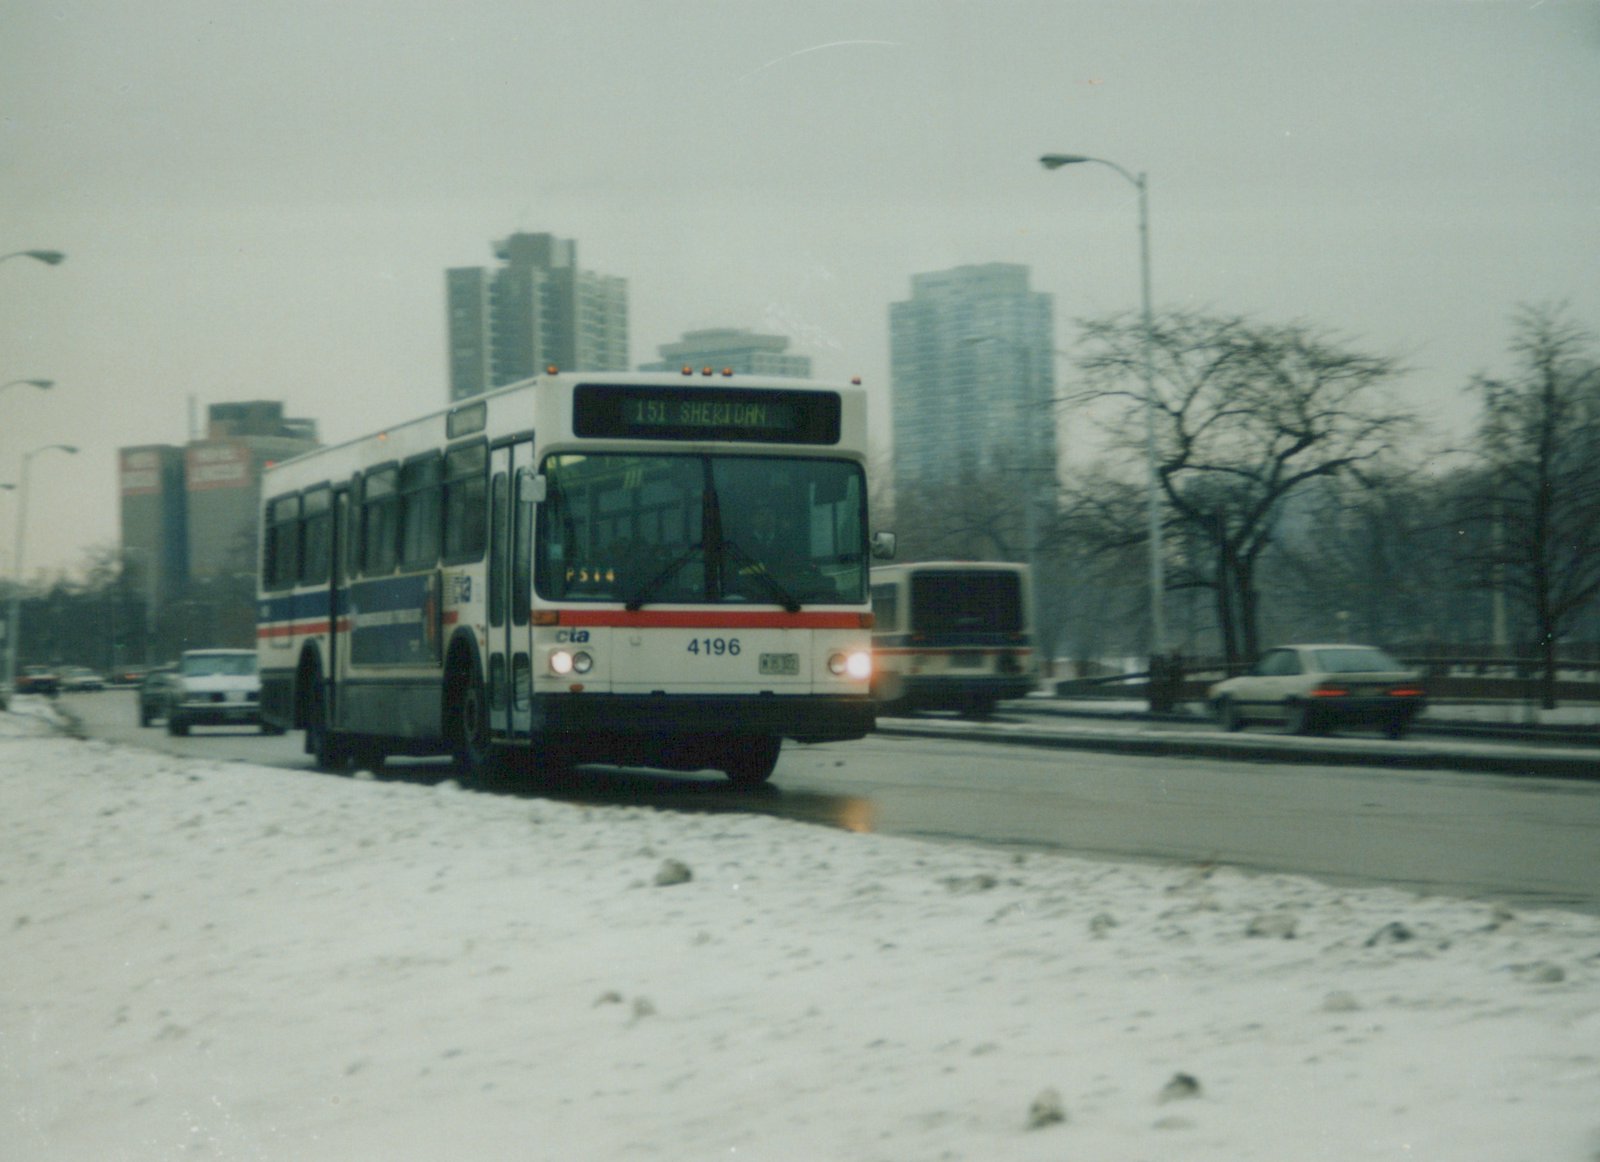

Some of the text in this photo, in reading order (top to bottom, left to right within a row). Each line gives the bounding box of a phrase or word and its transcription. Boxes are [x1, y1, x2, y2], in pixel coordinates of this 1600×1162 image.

[636, 400, 766, 426] 151 SHERIDAN
[555, 626, 590, 643] cta
[687, 637, 741, 656] 4196
